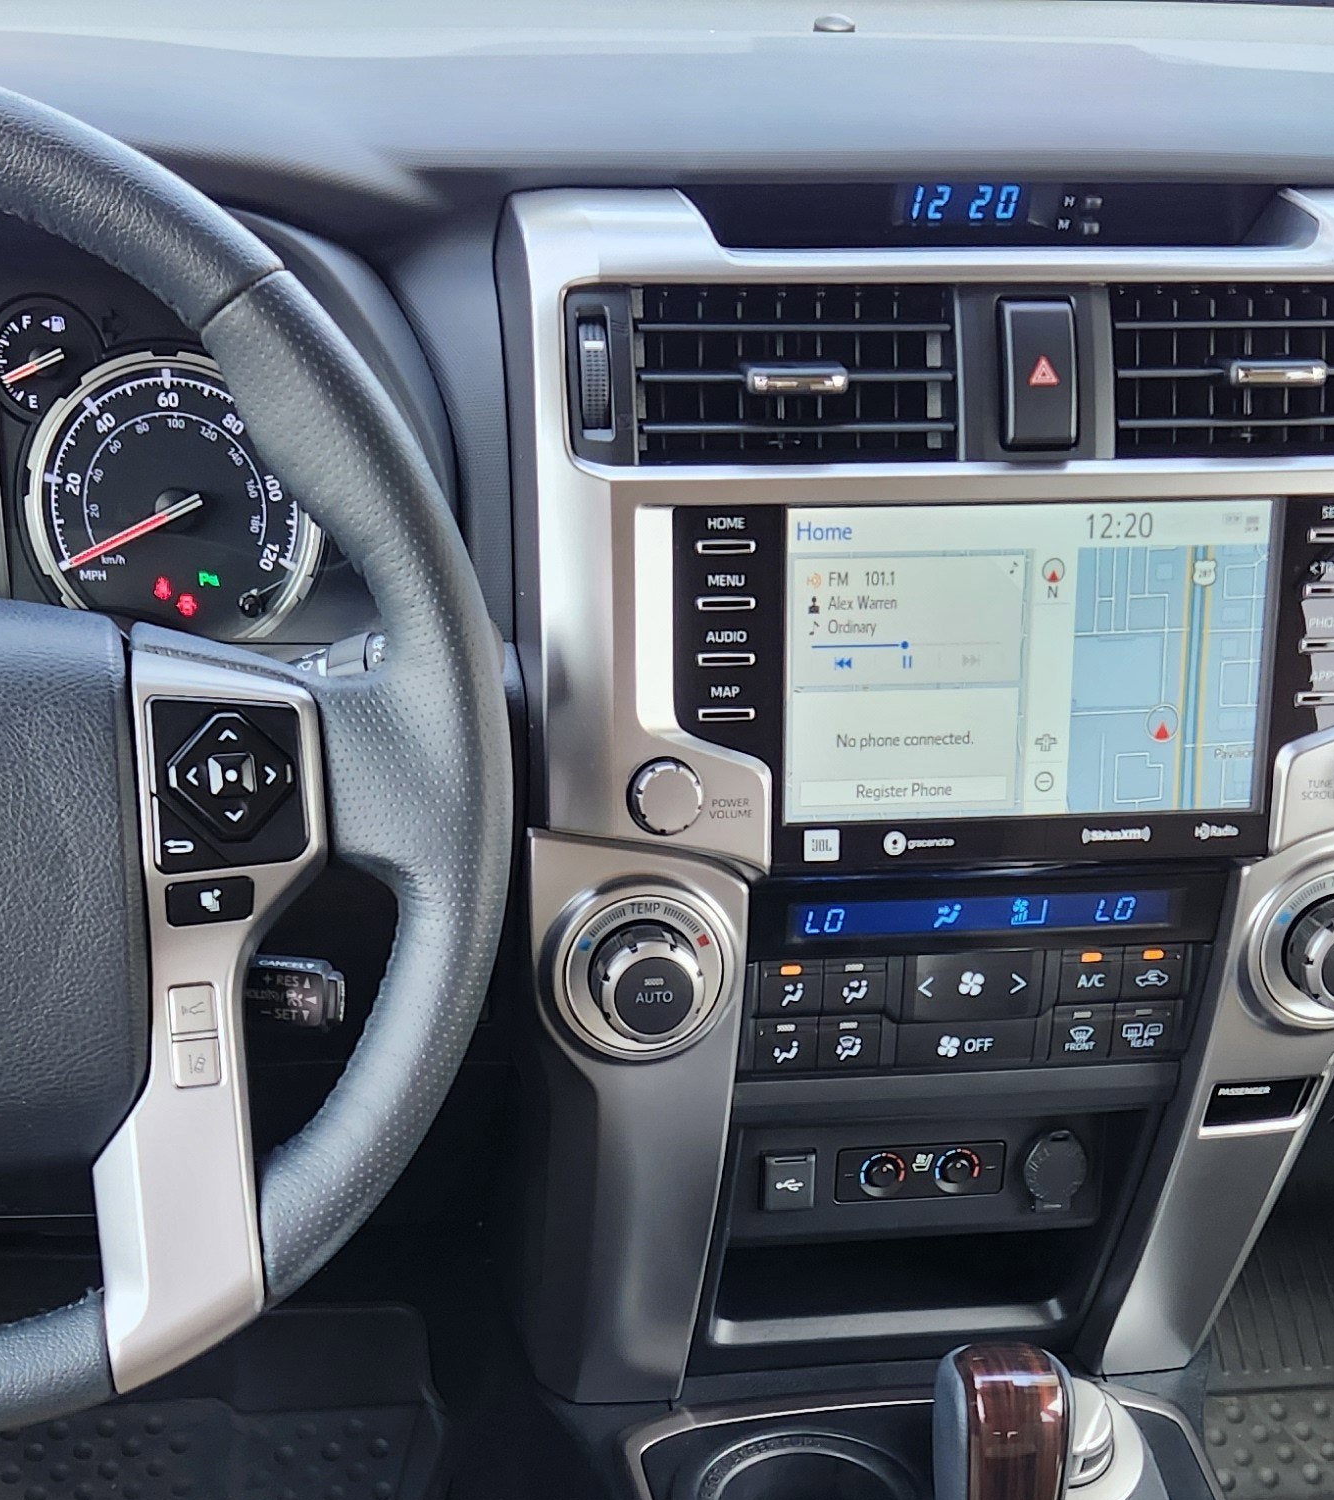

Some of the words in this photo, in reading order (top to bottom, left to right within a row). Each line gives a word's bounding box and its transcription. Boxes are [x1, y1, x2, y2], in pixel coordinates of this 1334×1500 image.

[1057, 219, 1071, 231] M
[21, 315, 32, 329] F
[28, 395, 39, 409] E
[157, 392, 179, 408] 60
[95, 412, 116, 434] 40
[135, 421, 150, 435] 80
[167, 418, 185, 430] 100
[221, 413, 245, 436] 80
[200, 425, 218, 442] 120
[108, 439, 122, 455] 60
[228, 447, 244, 467] 140
[92, 468, 104, 484] 40
[65, 472, 82, 496] 20
[245, 479, 259, 499] 160
[263, 475, 283, 502] 100
[90, 504, 100, 519] 20
[707, 516, 746, 531] HOME
[1085, 512, 1154, 539] 12:20
[796, 521, 853, 541] Home
[101, 554, 126, 566] km/h
[258, 543, 280, 572] 120
[79, 569, 107, 582] MPH
[707, 574, 745, 588] MENU
[828, 571, 849, 587] FM
[865, 571, 896, 587] 101.1
[1047, 585, 1059, 598] N
[828, 597, 853, 610] Alex
[857, 596, 898, 610] Warren
[827, 619, 877, 636] Ordinary
[706, 630, 747, 643] AUDIO
[710, 685, 740, 698] MAP
[836, 733, 856, 749] No
[859, 733, 901, 750] phone
[856, 784, 908, 801] Register
[910, 782, 953, 798] Phone
[1308, 779, 1333, 790] TUNE
[711, 798, 749, 808] POWER
[709, 809, 753, 819] VOLUME
[629, 902, 661, 915] TEMP
[258, 960, 305, 969] CANCEL
[276, 975, 299, 987] RES
[1077, 973, 1106, 988] A/C
[635, 990, 674, 1004] AUTO
[275, 1009, 298, 1020] SET
[964, 1037, 994, 1053] OFF
[1064, 1041, 1097, 1051] FRONT
[1130, 1038, 1155, 1048] REAR
[1218, 1086, 1271, 1096] PASSENGER
